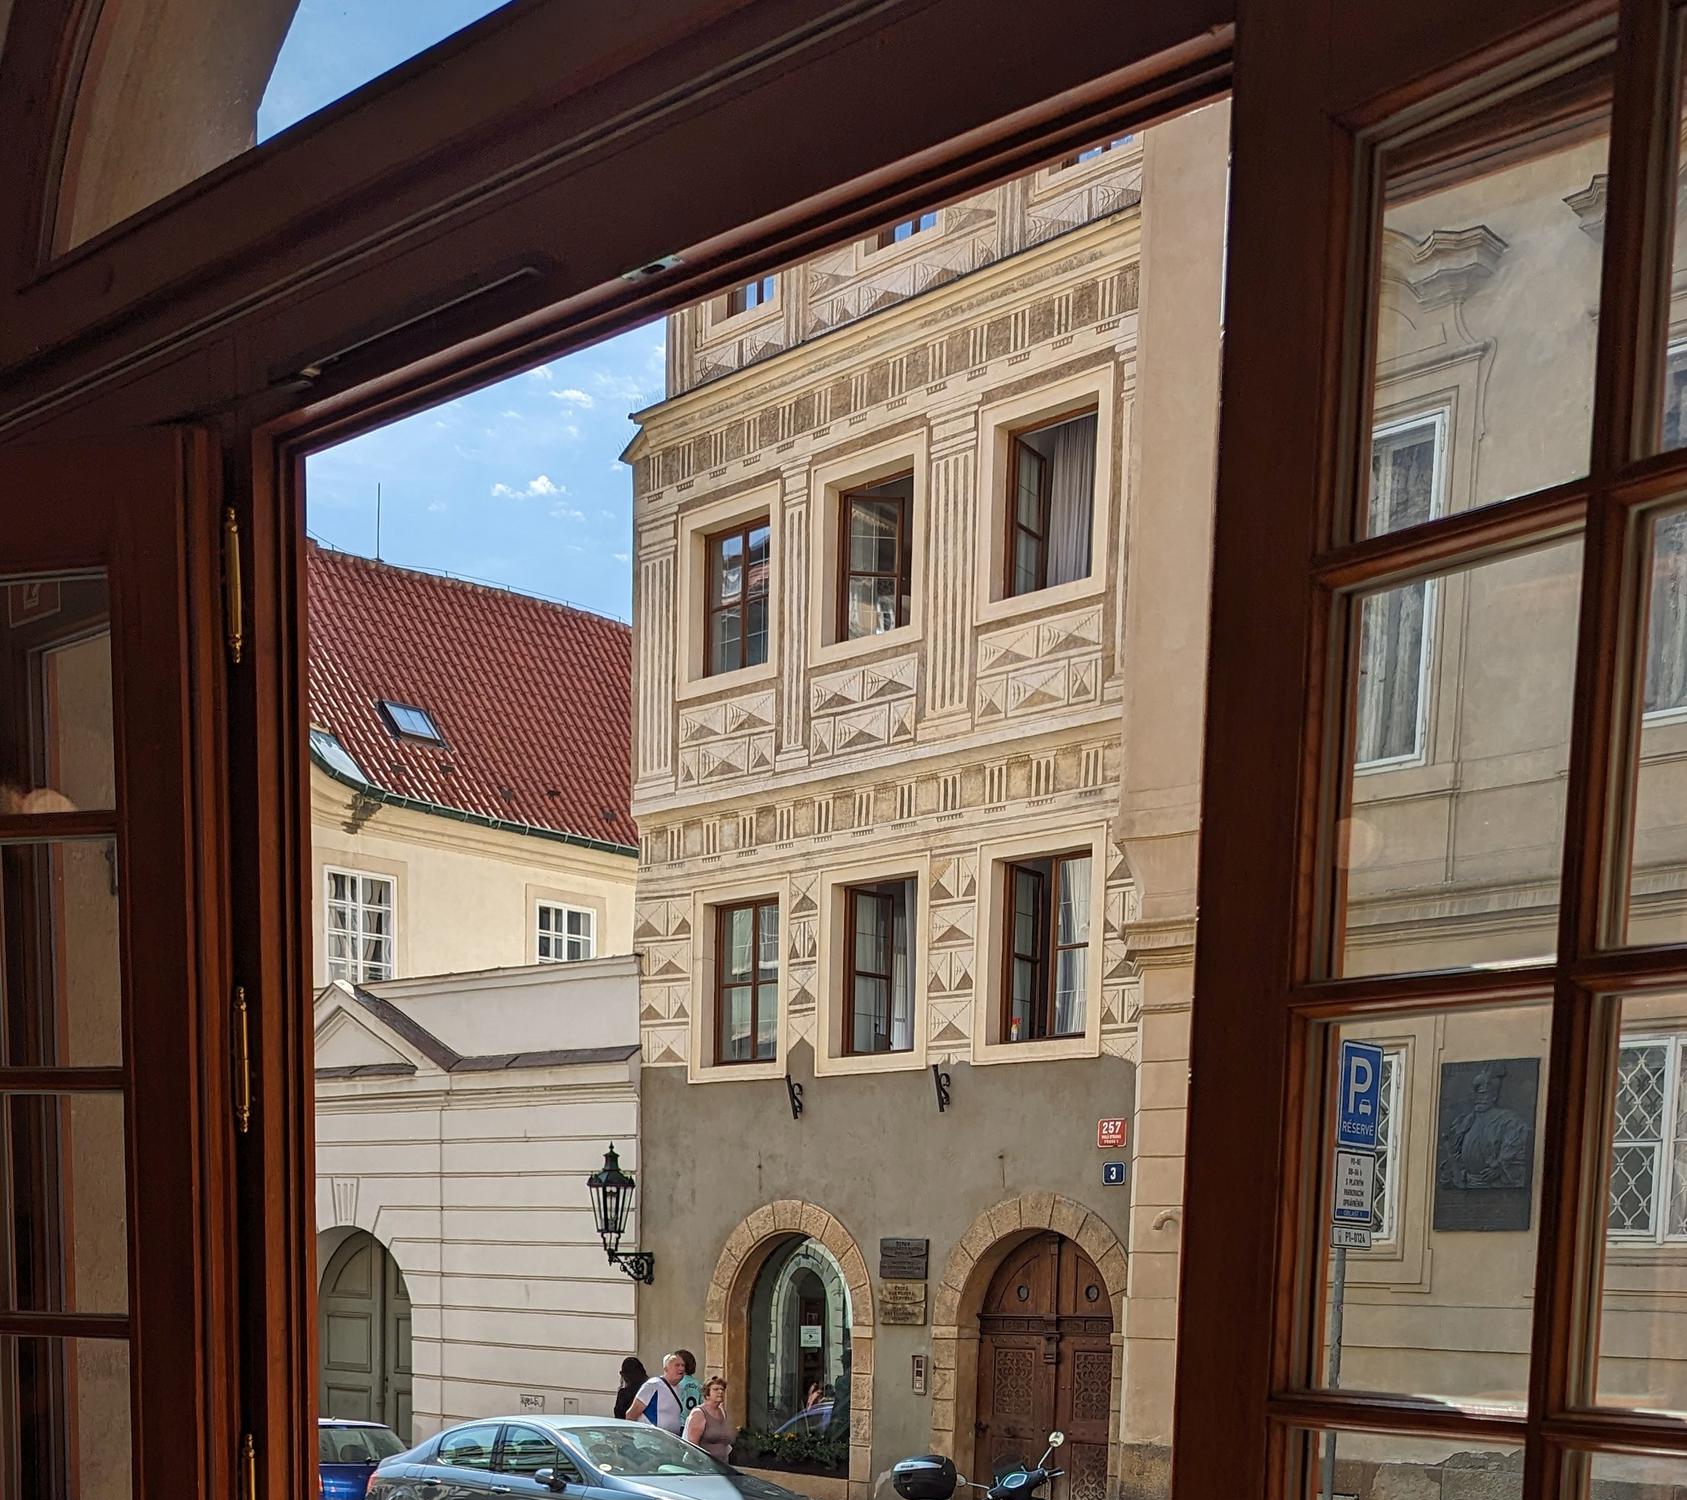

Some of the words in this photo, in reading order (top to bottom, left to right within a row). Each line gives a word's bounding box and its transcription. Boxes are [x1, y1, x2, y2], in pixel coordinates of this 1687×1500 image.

[1347, 1056, 1373, 1114] P
[1102, 1121, 1121, 1134] 257
[1342, 1119, 1374, 1136] RÉSERVÉ
[1110, 1166, 1117, 1180] 3
